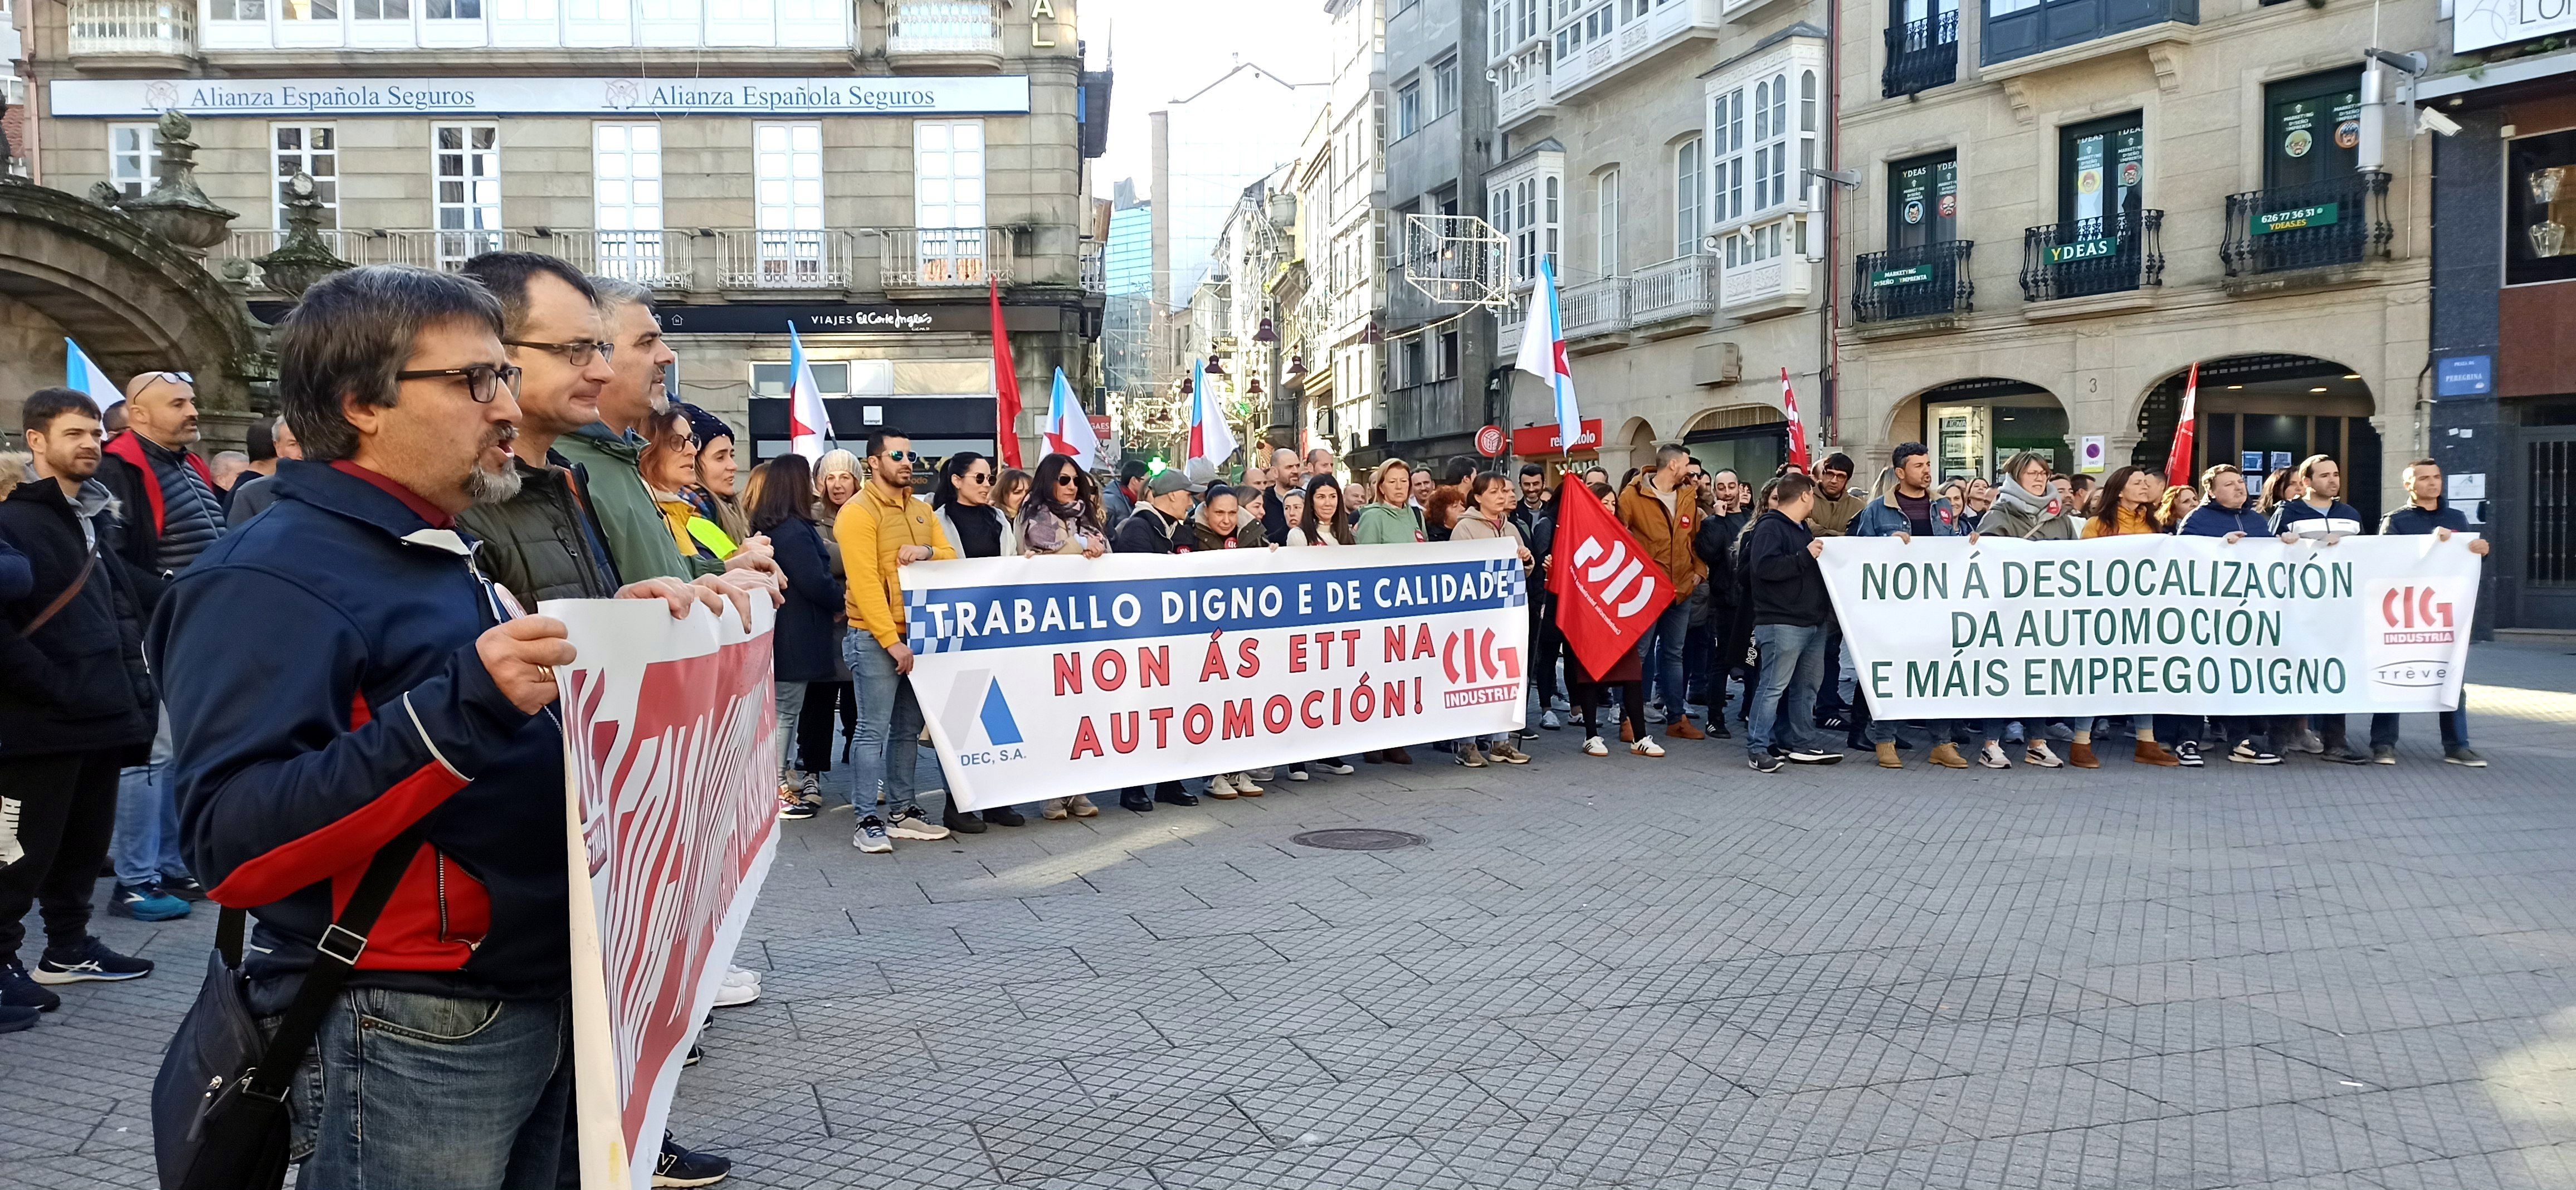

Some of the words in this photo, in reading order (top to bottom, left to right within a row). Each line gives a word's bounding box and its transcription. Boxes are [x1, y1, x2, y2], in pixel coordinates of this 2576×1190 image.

[191, 87, 273, 106] Alianza
[283, 86, 380, 110] Española
[388, 85, 474, 110] Seguros
[652, 86, 733, 106] Alianza
[743, 85, 841, 110] Española
[850, 86, 934, 110] Seguros
[1903, 167, 1926, 178] YDEAS
[2261, 214, 2279, 223] 626
[2280, 212, 2291, 221] 77
[2292, 210, 2304, 219] 36
[2305, 208, 2315, 217] 31
[2270, 219, 2307, 230] YDEAS.ES
[2051, 241, 2107, 261] YDEAS
[1885, 269, 1916, 277] MARKETYNG
[811, 316, 852, 326] VIAJES
[856, 312, 868, 324] El
[868, 312, 894, 324] Corte
[895, 309, 932, 328] Inglés
[2090, 378, 2097, 393] 3
[2446, 373, 2482, 382] PEREGRINA
[1862, 562, 1948, 600] NON
[1962, 550, 1989, 599] Á
[2003, 553, 2353, 598] DESLOCALIZACIÓN
[926, 593, 1141, 639] TRABALLO
[1162, 584, 1282, 625] DIGNO
[1299, 584, 1312, 614] E
[1327, 581, 1362, 612] DE
[1374, 571, 1509, 608] CALIDADE
[2383, 587, 2453, 628] CIG
[1951, 611, 2004, 648] DA
[2015, 601, 2281, 646] AUTOMOCIÓN
[2385, 632, 2453, 644] INDUSTRIA
[1053, 645, 1170, 696] NON
[1199, 627, 1260, 682] ÁS
[1290, 629, 1361, 674] ETT
[1384, 623, 1436, 663] NA
[1443, 628, 1520, 685] CIG
[1872, 661, 1893, 698] E
[1907, 649, 2010, 698] MÁIS
[2024, 656, 2221, 696] EMPREGO
[2231, 658, 2346, 695] DIGNO
[1445, 686, 1519, 709] INDUSTRIA
[1070, 671, 1423, 760] AUTOMOCIÓN!
[1000, 750, 1027, 762] S.A.
